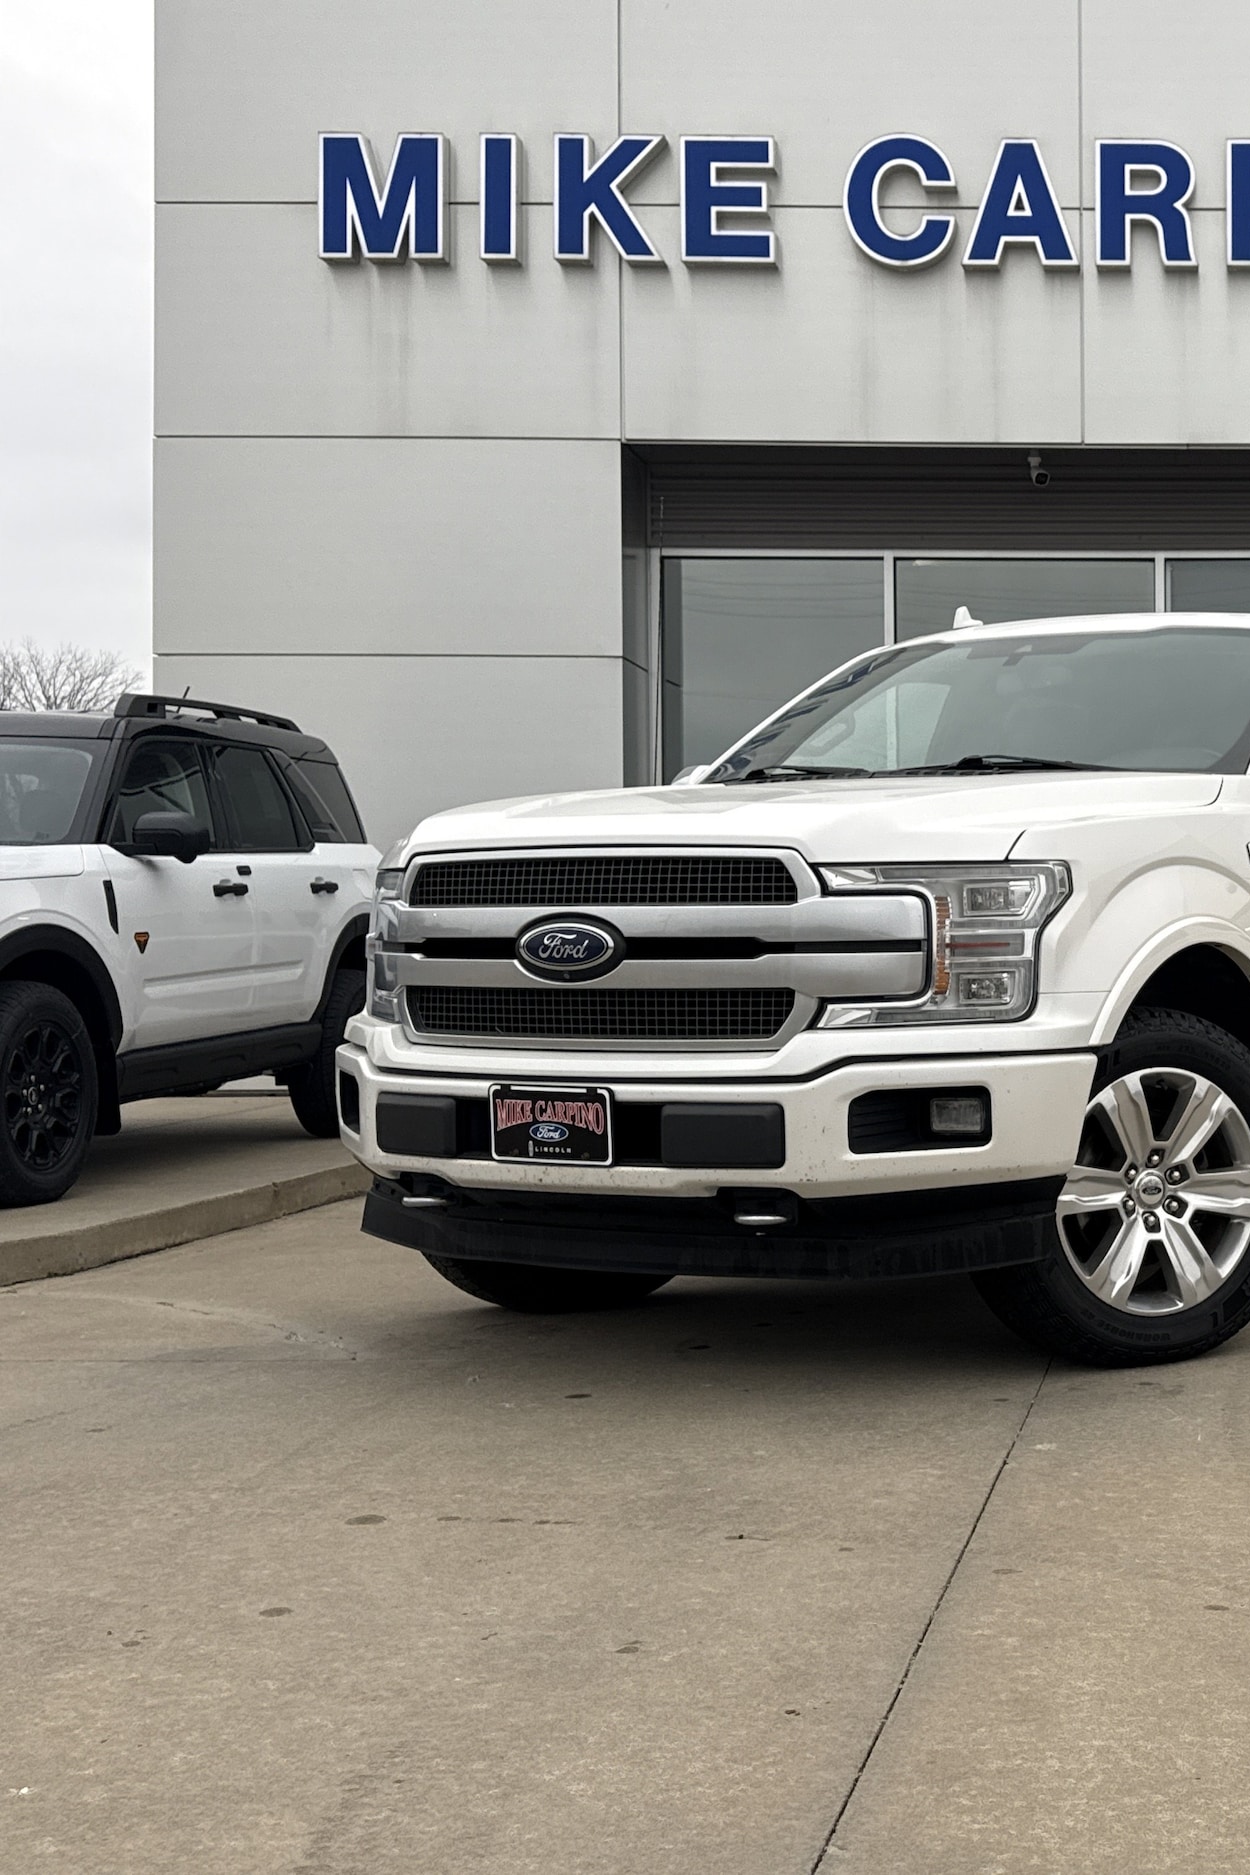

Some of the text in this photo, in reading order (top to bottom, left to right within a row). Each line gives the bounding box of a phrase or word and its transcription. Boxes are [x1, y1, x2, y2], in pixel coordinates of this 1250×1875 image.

[317, 132, 778, 265] MIKE
[538, 932, 589, 959] Ford
[495, 1098, 605, 1135] MIKE CARPINO
[536, 1125, 561, 1140] Ford
[534, 1146, 572, 1154] LINCOLN
